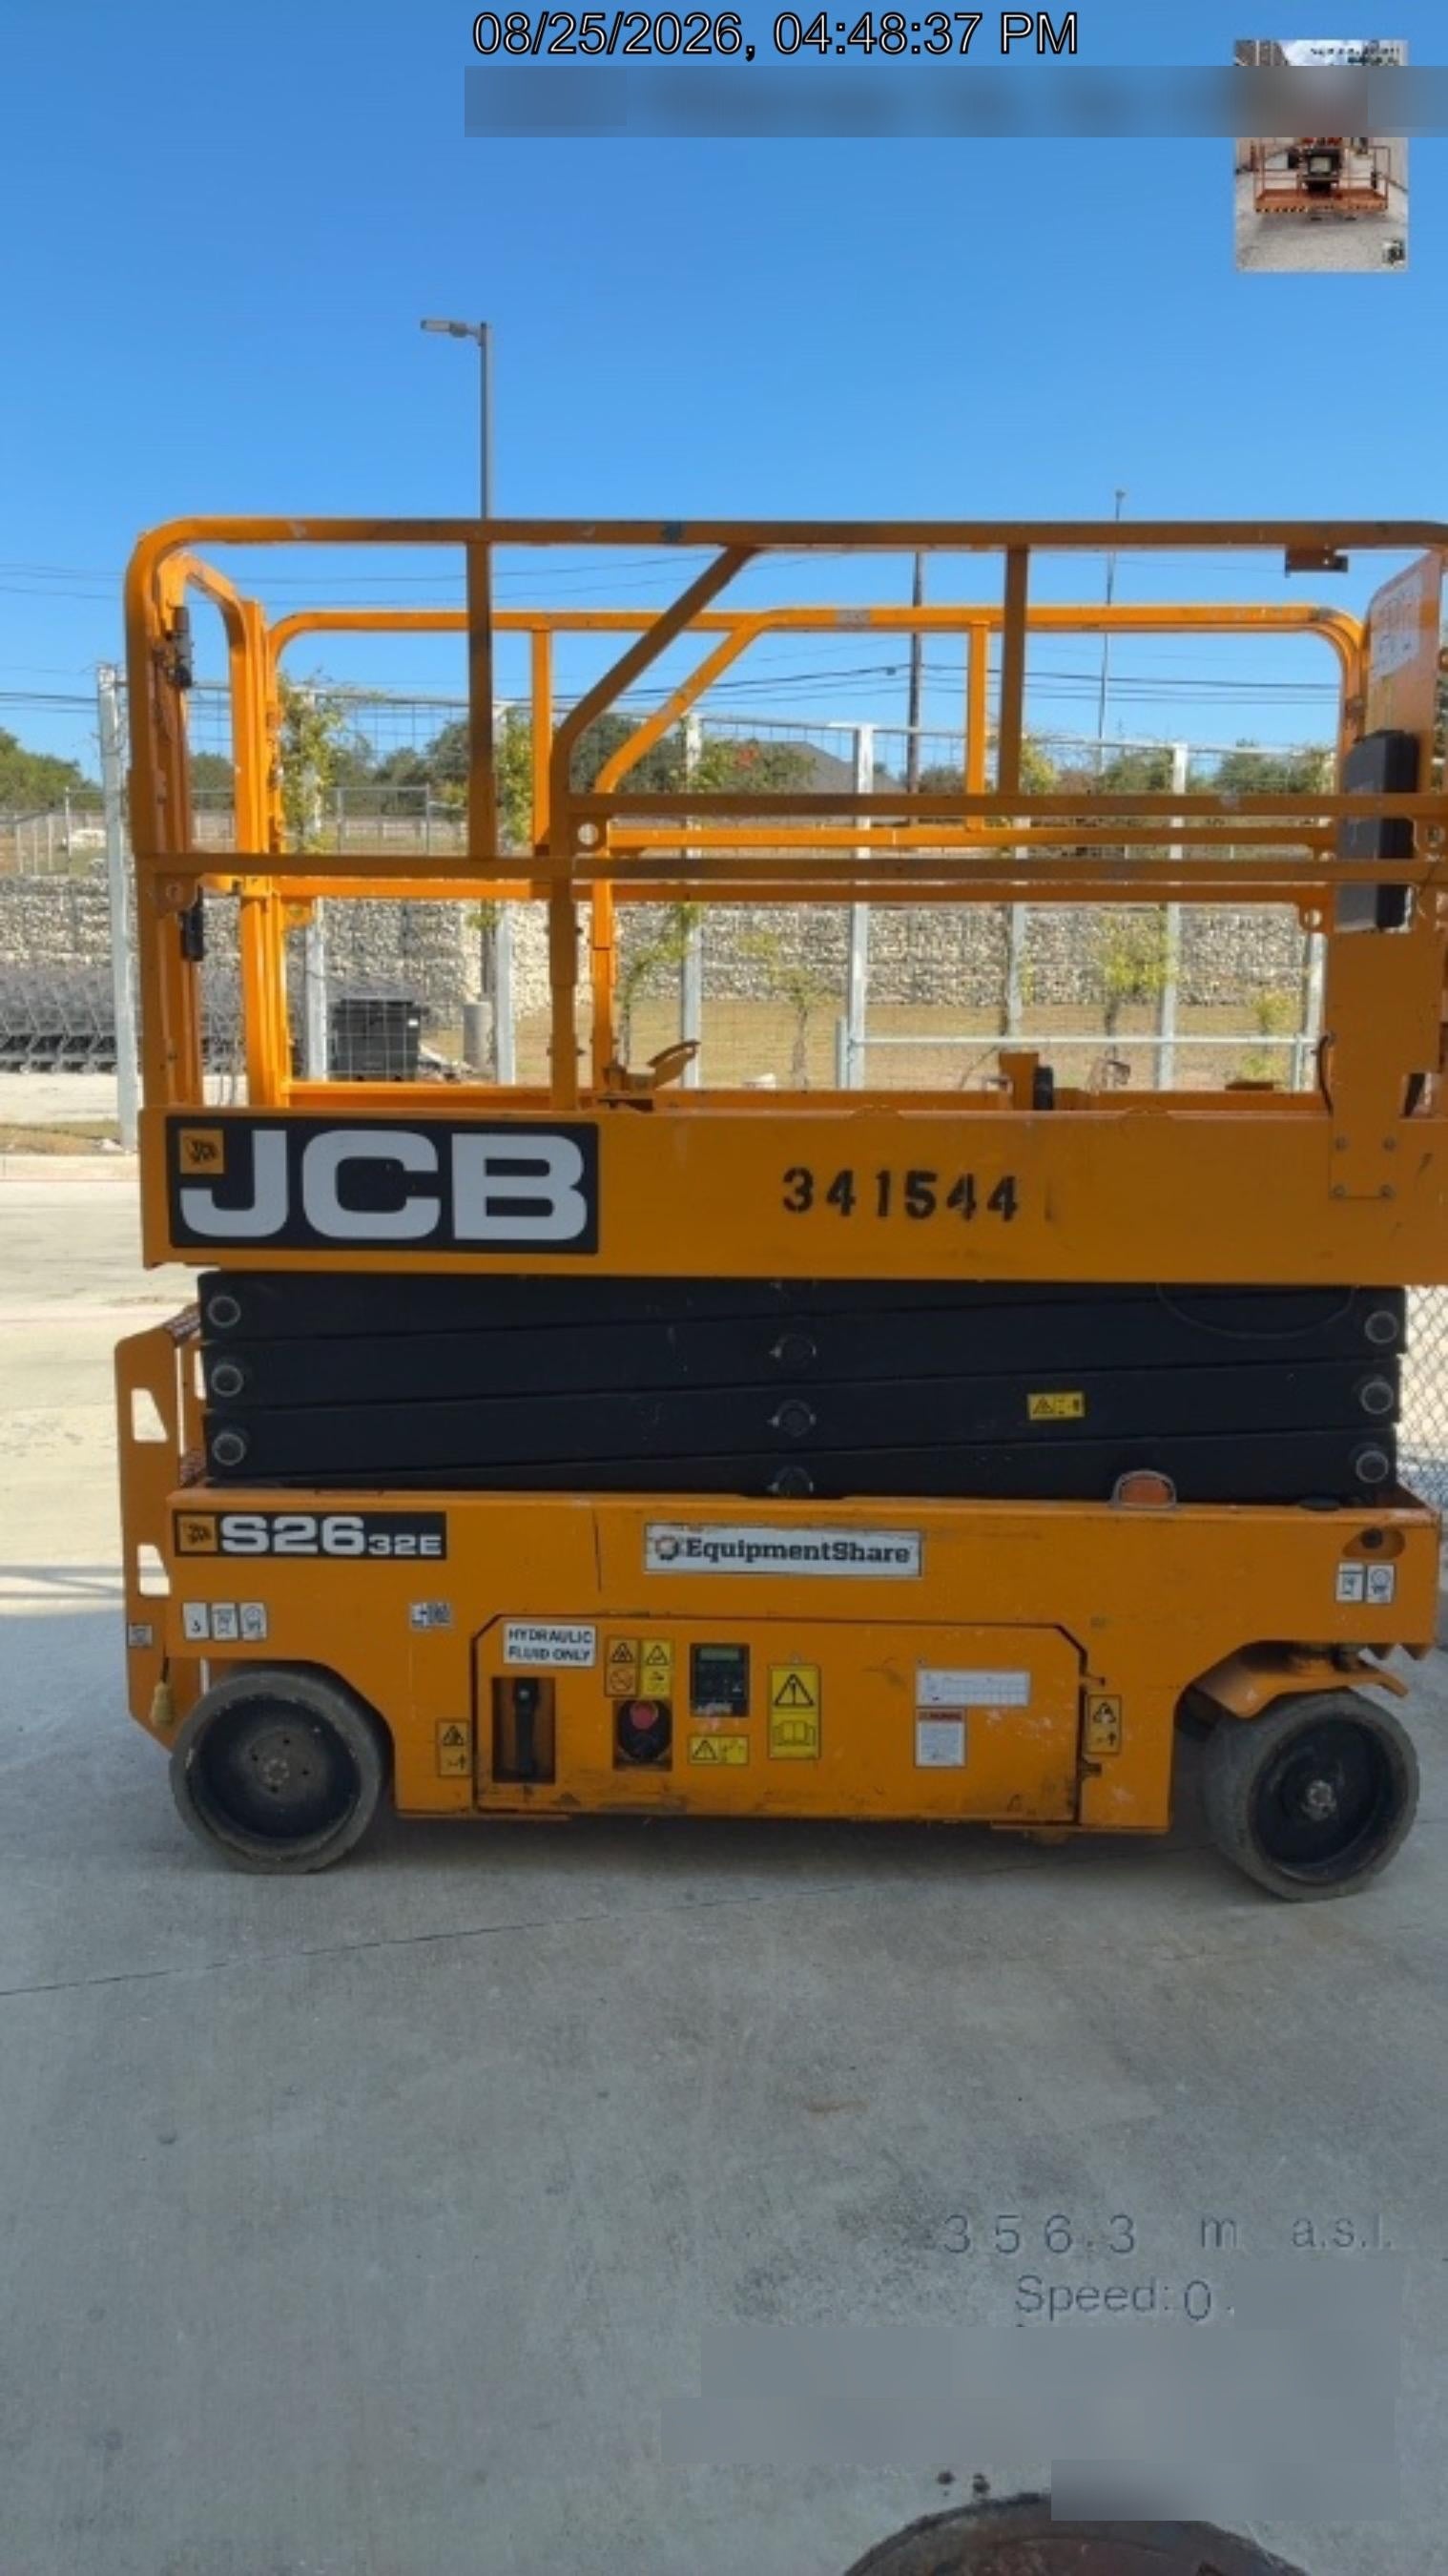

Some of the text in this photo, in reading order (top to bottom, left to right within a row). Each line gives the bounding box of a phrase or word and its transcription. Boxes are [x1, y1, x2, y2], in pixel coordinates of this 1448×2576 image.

[179, 1130, 588, 1240] JCB
[782, 1167, 1019, 1222] 341544
[220, 1515, 365, 1555] S26
[368, 1534, 443, 1556] 32E
[685, 1538, 910, 1564] EquipmentShare
[508, 1628, 592, 1644] HYDRAULIC
[508, 1646, 590, 1661] FLUID ONLY
